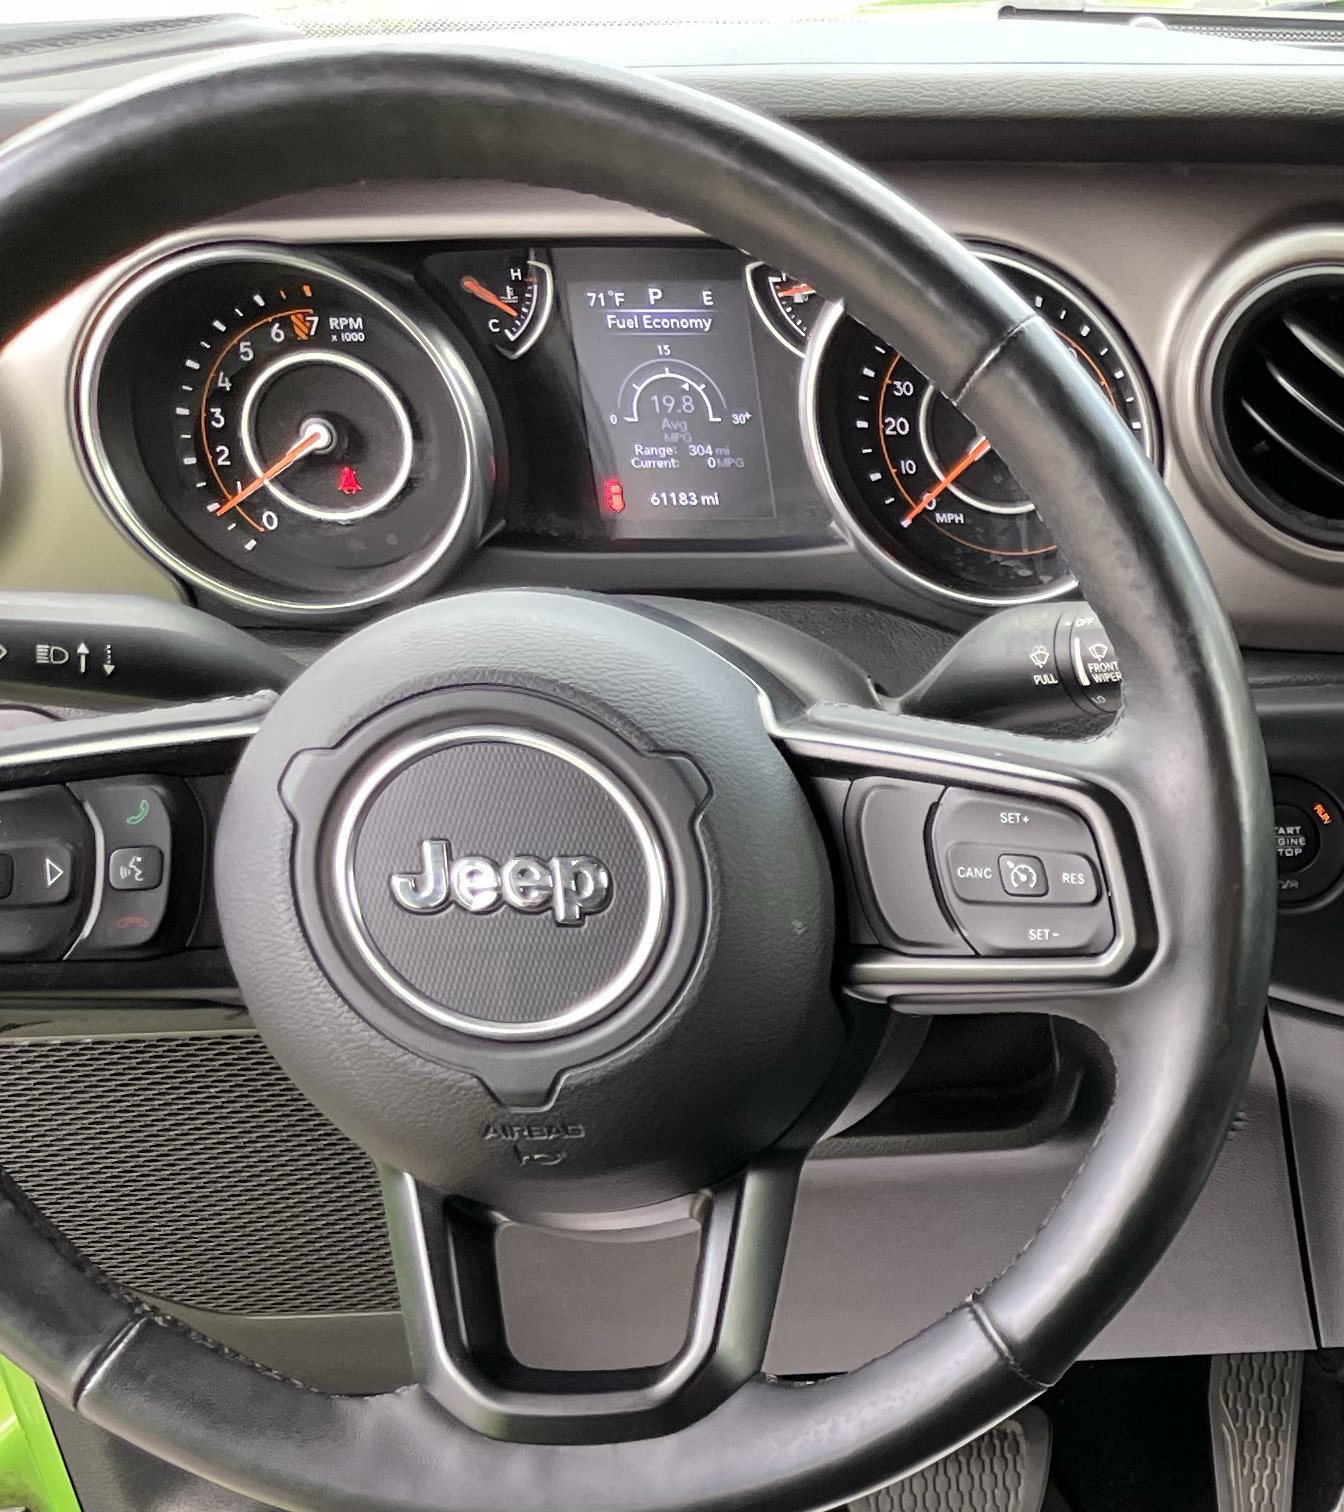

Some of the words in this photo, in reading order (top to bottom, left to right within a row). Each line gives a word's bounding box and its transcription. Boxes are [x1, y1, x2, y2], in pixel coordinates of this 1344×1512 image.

[511, 269, 521, 281] H
[648, 289, 663, 306] P
[703, 291, 714, 306] E
[306, 317, 320, 335] 7
[329, 317, 363, 330] RPM
[488, 320, 500, 332] C
[607, 315, 639, 329] Fuel
[643, 315, 712, 332] Economy
[270, 323, 285, 341] 6
[341, 332, 365, 342] 1000
[239, 342, 254, 362] 5
[657, 345, 671, 355] 15
[217, 372, 232, 391] 4
[893, 381, 914, 396] 30
[651, 395, 695, 413] 19.8
[210, 408, 225, 427] 3
[610, 415, 618, 424] 0
[661, 418, 687, 434] Avg
[885, 417, 909, 435] 20
[664, 432, 692, 443] MPG
[216, 446, 231, 466] 2
[634, 445, 677, 458] Range:
[688, 445, 713, 456] 304
[715, 445, 730, 456] mi
[631, 458, 680, 469] Current:
[717, 458, 745, 469] MPG
[900, 460, 917, 475] 10
[650, 492, 699, 506] 61183
[701, 492, 719, 506] mi
[262, 511, 278, 531] 0
[935, 513, 965, 524] MPH
[1075, 617, 1095, 627] OFF
[1088, 661, 1119, 674] FRONT
[1033, 674, 1058, 685] PULL
[1091, 672, 1122, 683] WIPER
[957, 866, 993, 879] CANC
[1062, 873, 1085, 885] RES
[390, 837, 614, 928] Jeep
[484, 1124, 586, 1140] AIRBAG
